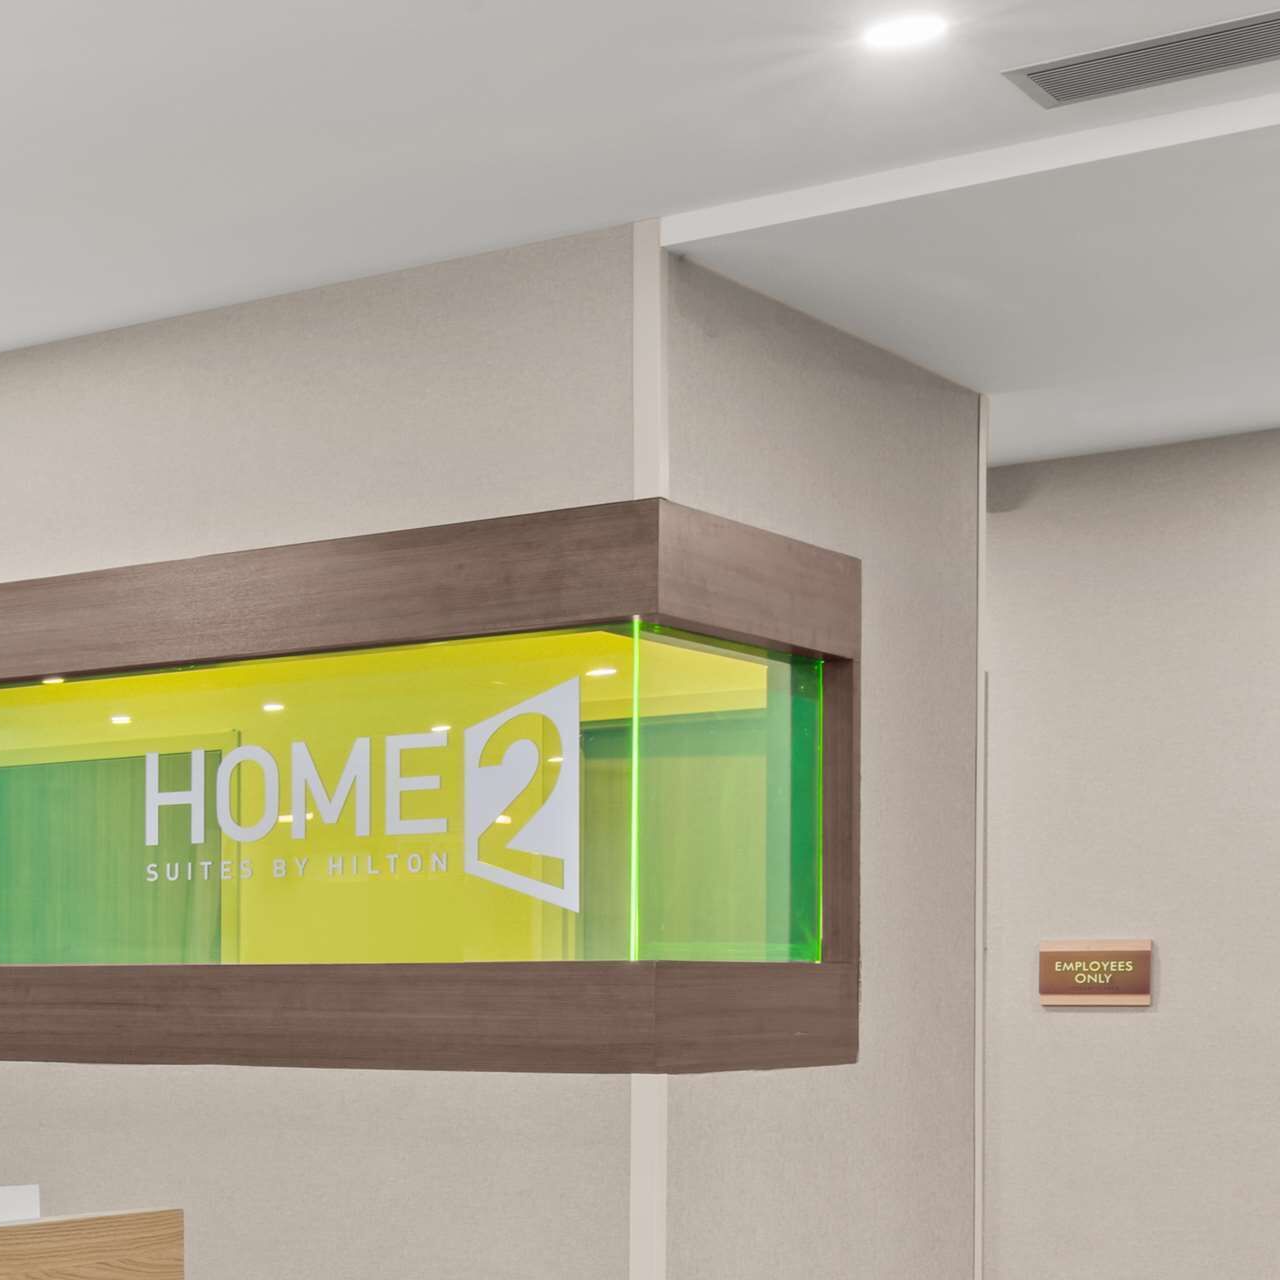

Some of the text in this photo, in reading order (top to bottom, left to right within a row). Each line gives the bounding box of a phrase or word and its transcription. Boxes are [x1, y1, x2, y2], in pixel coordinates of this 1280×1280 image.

[144, 700, 570, 900] HOME 2
[146, 851, 449, 882] SUITES BY HILTON
[1055, 960, 1134, 972] EMPLOYEES
[1074, 973, 1112, 984] ONLY
